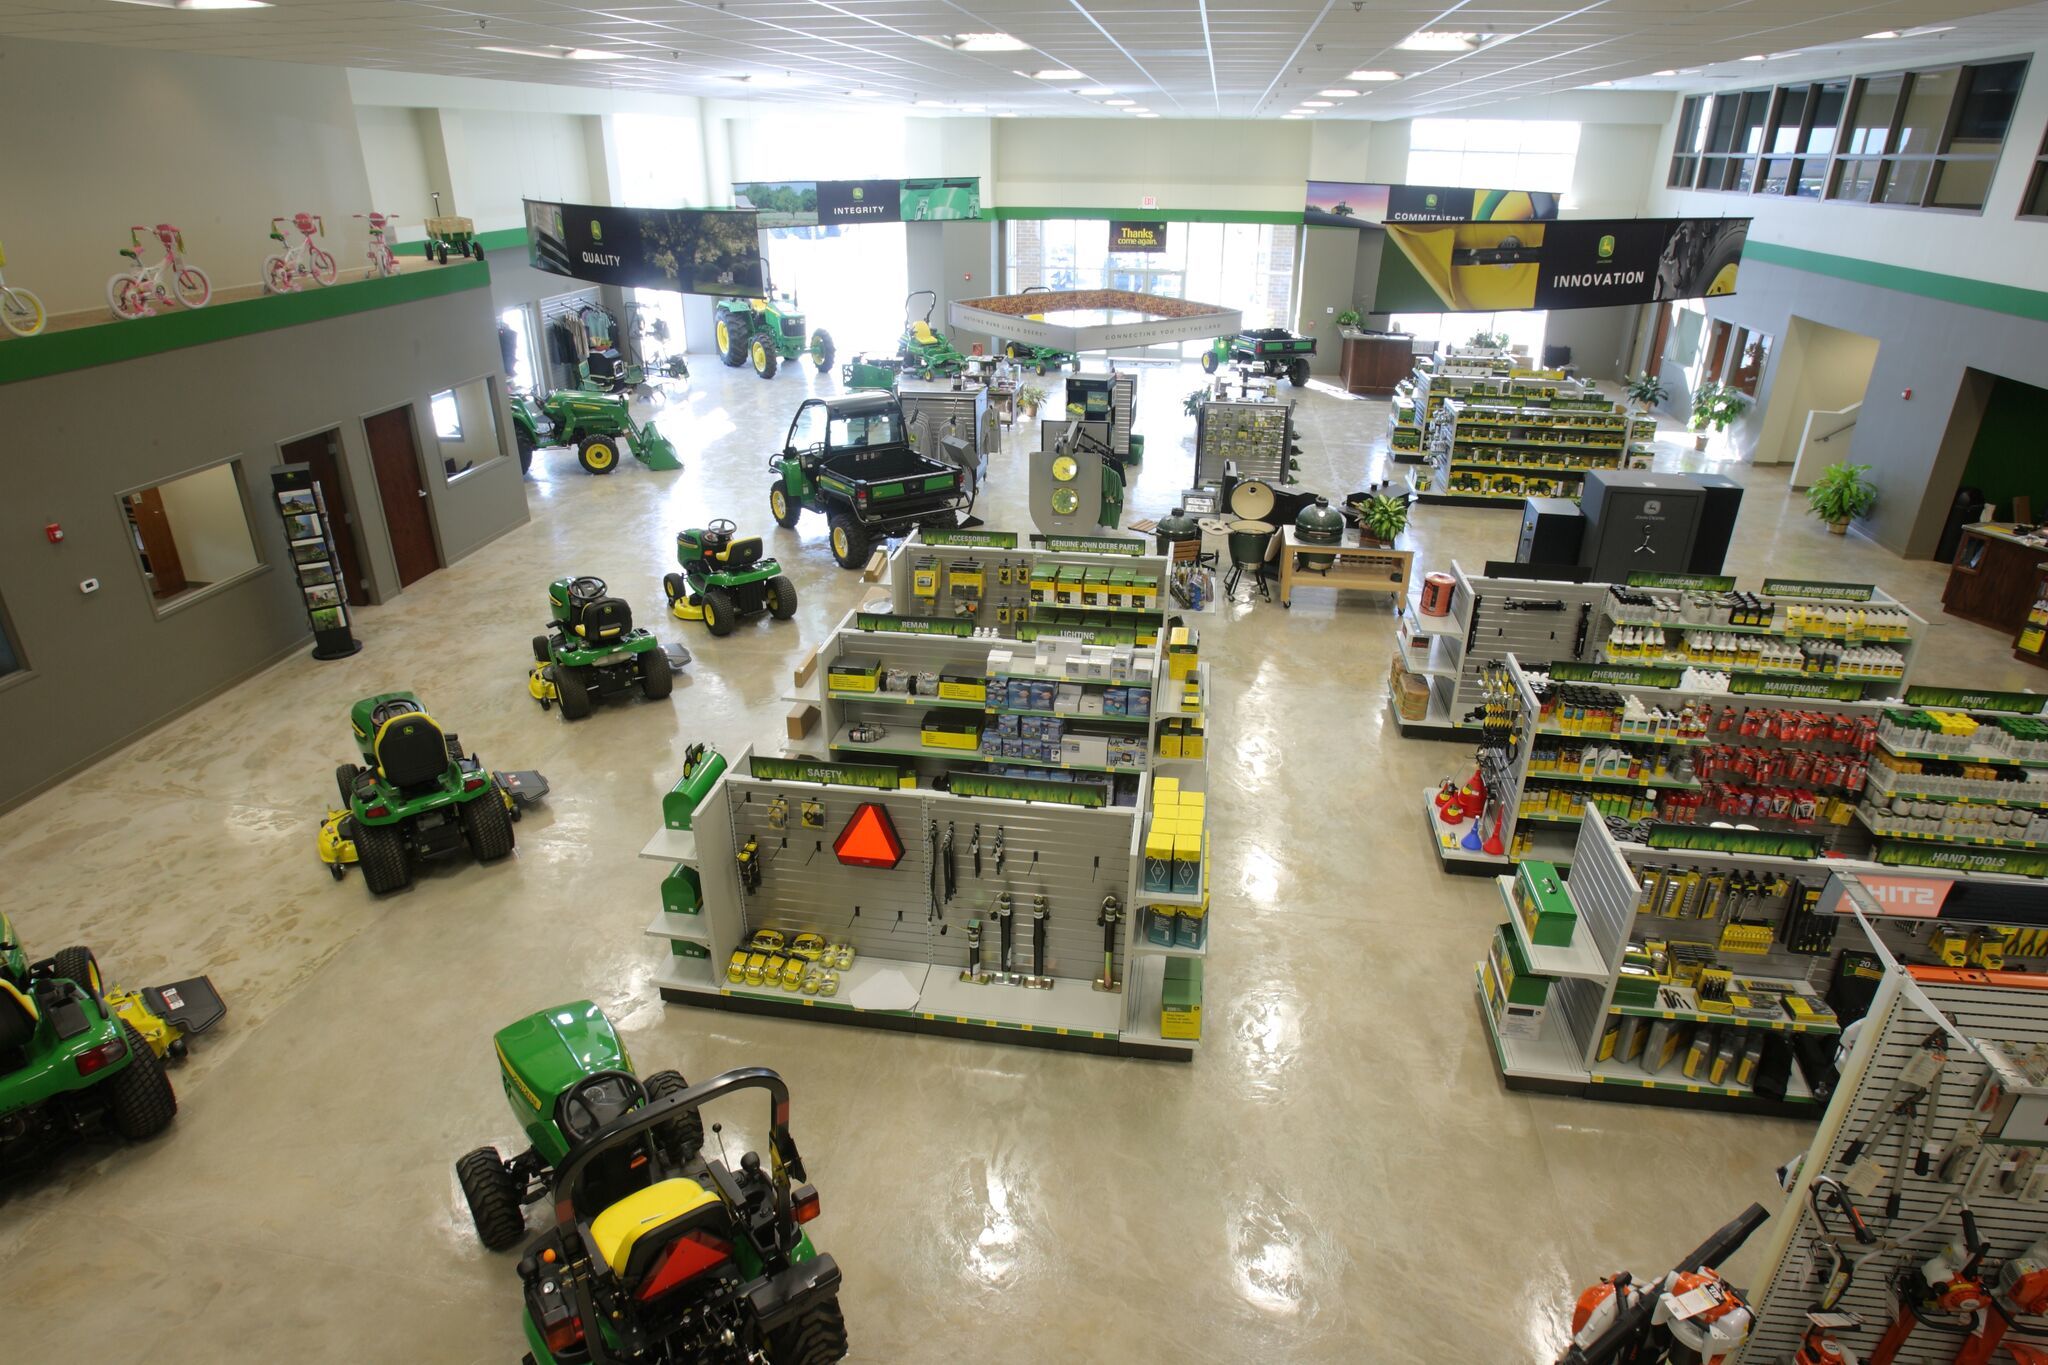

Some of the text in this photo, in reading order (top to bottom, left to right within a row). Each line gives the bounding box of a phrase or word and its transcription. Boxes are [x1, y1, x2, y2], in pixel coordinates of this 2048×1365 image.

[834, 206, 884, 215] INTEGRITY
[1121, 227, 1153, 239] Thanks
[582, 251, 620, 267] QUALITY
[1553, 271, 1645, 288] INNOVATION
[1105, 330, 1157, 340] CONNECTING
[948, 535, 991, 543] ACCESSORIES
[1051, 540, 1139, 551] GENUINE JOHN DEERE PARTS
[1659, 577, 1704, 587] LUBRICANTS
[1770, 583, 1869, 597] GENUINE JOHN DEERE PARTS
[902, 621, 929, 629] REMAN
[1060, 630, 1095, 640] LIGHTING
[1591, 670, 1641, 681] CHEMICALS
[1764, 682, 1829, 694] MAINTENANCE
[1960, 695, 1990, 704] PAINT
[807, 768, 842, 779] SAFETY
[1932, 852, 2007, 867] HAND TOOLS
[1859, 960, 1871, 968] 20
